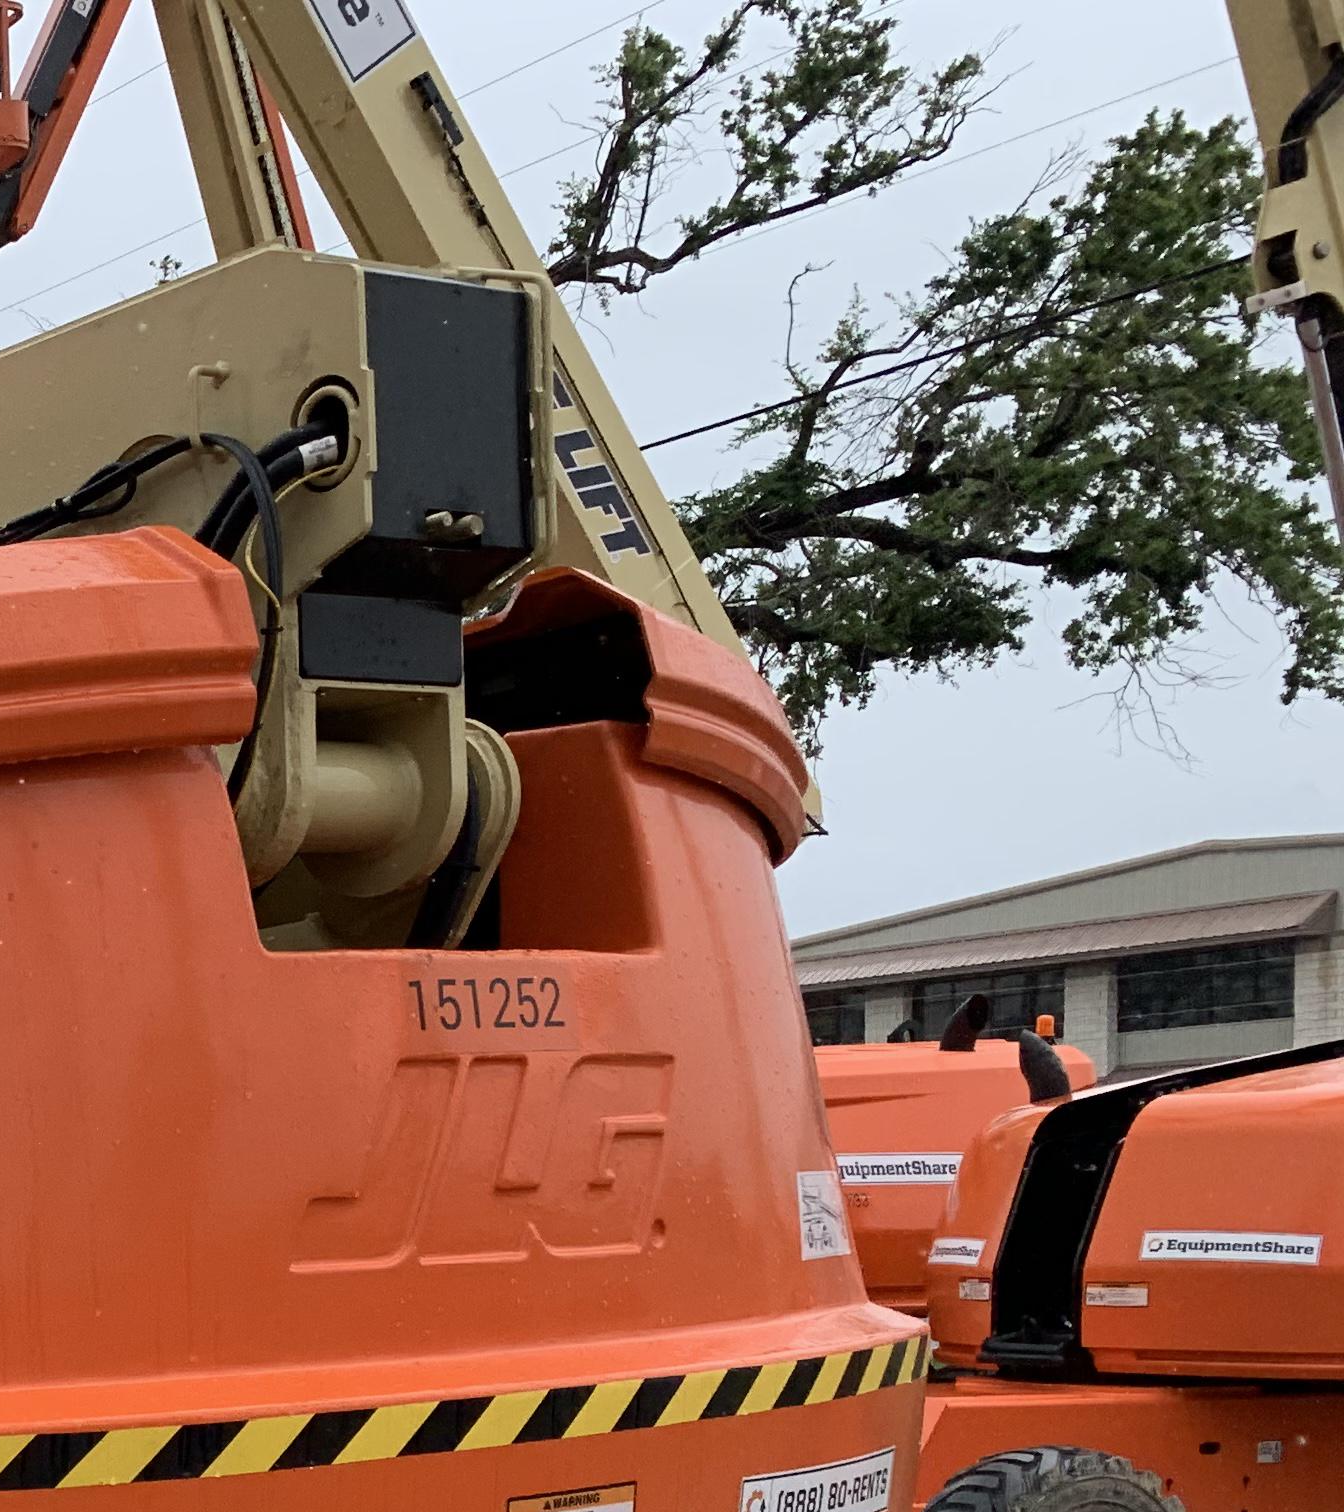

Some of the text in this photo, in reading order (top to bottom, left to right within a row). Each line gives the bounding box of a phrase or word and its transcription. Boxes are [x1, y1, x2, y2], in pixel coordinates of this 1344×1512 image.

[554, 429, 652, 556] LIFT
[408, 977, 566, 1031] 151252
[289, 1052, 675, 1272] JLG
[840, 1161, 957, 1179] quipmentShare
[1166, 1239, 1314, 1255] EquipmentShare
[553, 1493, 600, 1508] WARNING
[828, 1469, 888, 1510] 80-RENTS
